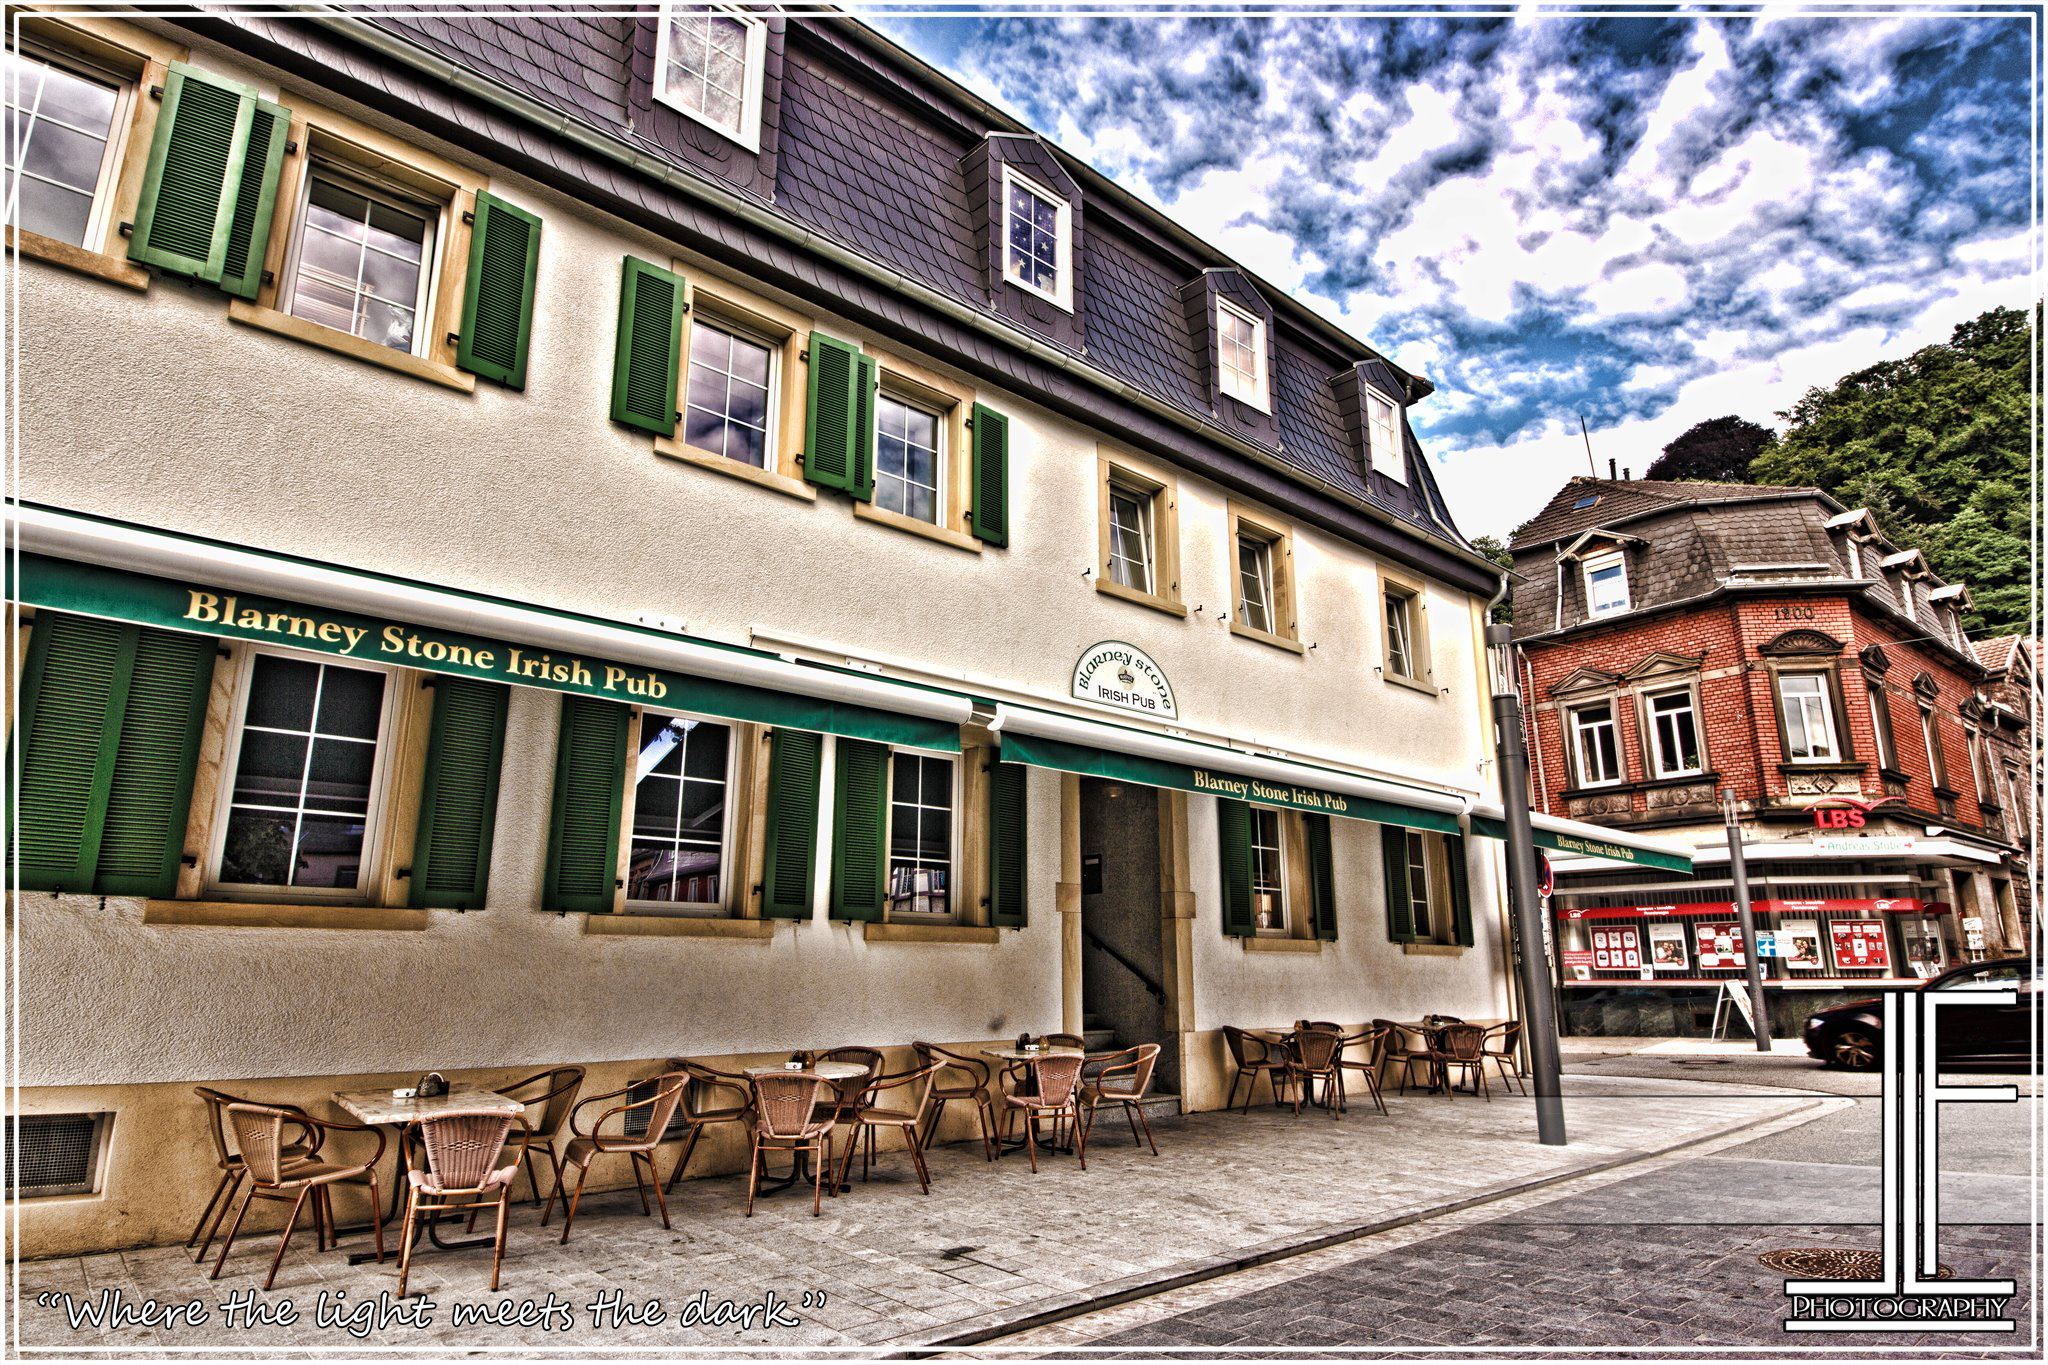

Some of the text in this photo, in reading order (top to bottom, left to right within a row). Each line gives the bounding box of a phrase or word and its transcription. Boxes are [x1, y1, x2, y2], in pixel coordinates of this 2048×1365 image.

[1775, 606, 1814, 620] 1900
[183, 589, 667, 699] Blarney Stone Irish Pub
[1194, 770, 1347, 812] Blarney Stone Irish Pub
[1814, 808, 1866, 829] LBS
[1556, 834, 1634, 860] Blarney Stone Irish Pub
